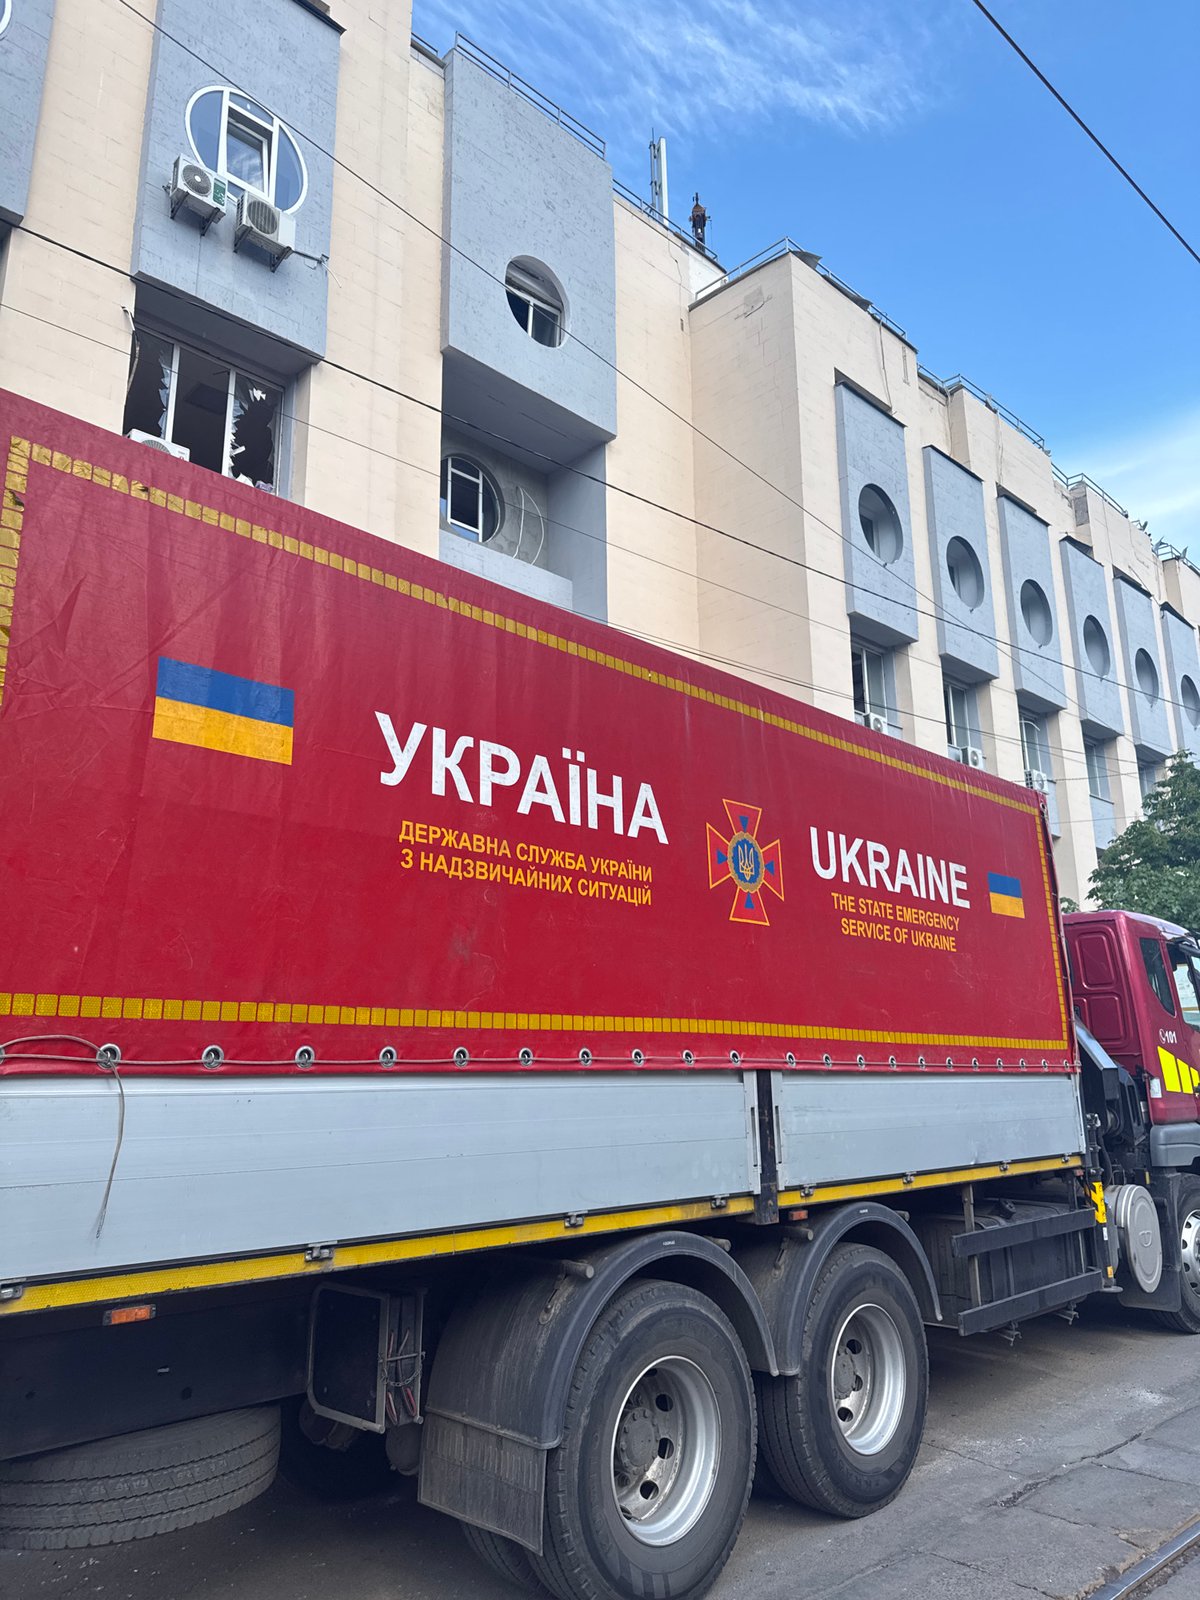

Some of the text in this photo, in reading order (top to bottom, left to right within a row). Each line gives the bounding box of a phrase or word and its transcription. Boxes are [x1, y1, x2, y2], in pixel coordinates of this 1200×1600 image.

[374, 710, 669, 845] УКРАЇНА
[398, 819, 653, 884] ДЕРЖАВНА СЛУЖБА УКРАЇНИ
[400, 848, 653, 907] З НАДЗВИЧАЙНИХ СИТУАЦІЙ
[809, 825, 971, 909] UKRAINE
[831, 892, 960, 932] THE STATE EMERGENCY
[841, 917, 957, 953] SERVICE OF UKRAINE
[1165, 1030, 1178, 1044] 101
